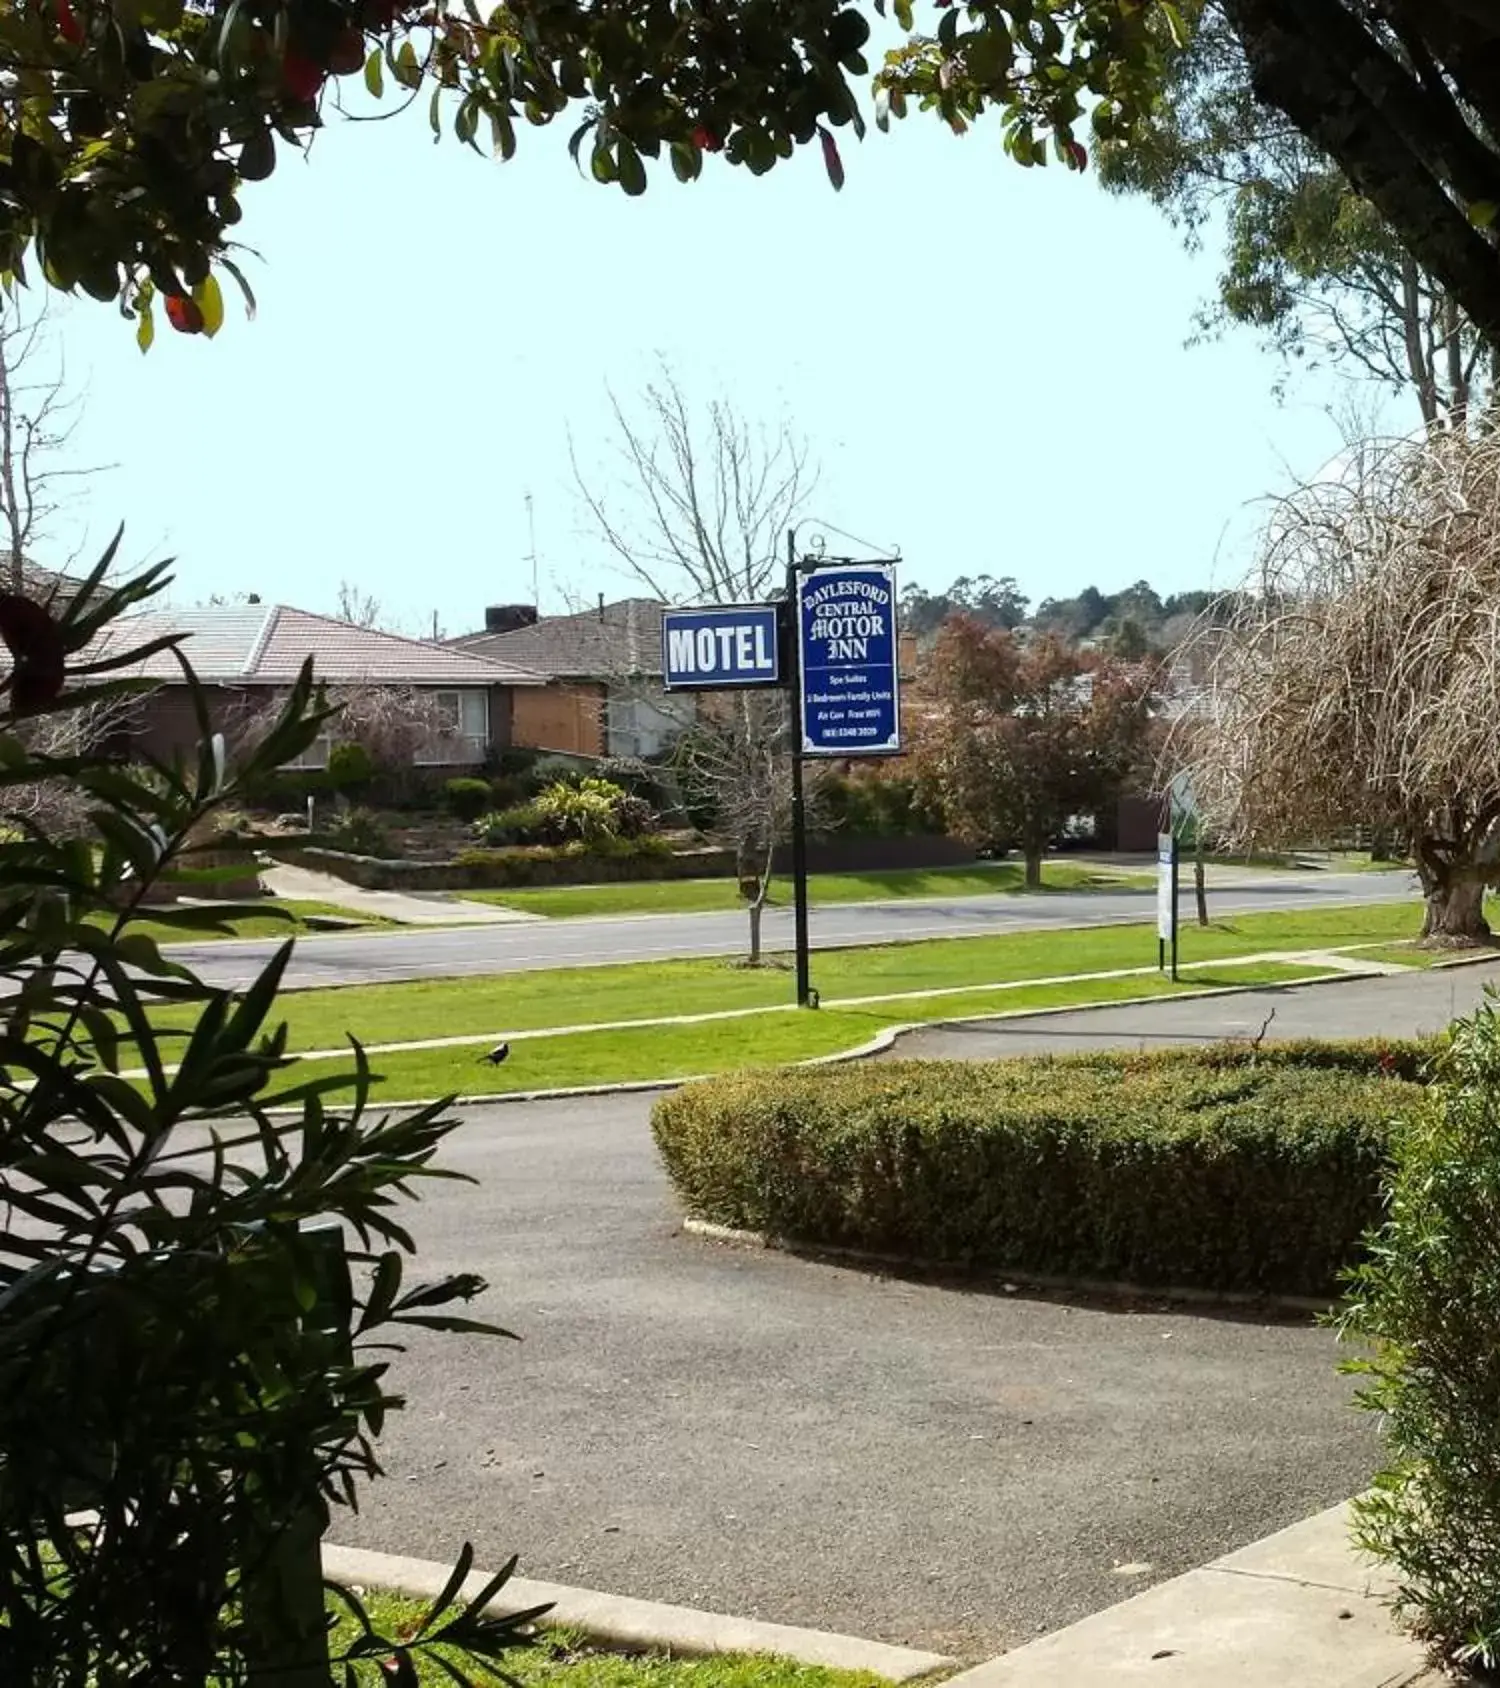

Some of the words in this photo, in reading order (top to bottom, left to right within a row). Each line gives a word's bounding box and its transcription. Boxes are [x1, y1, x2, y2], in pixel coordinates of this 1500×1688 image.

[804, 581, 889, 611] DAYLESFORD
[815, 600, 876, 617] CENTRAL
[809, 616, 885, 640] MOTOR
[668, 625, 773, 673] MOTEL
[827, 638, 868, 660] INN
[847, 691, 870, 703] Family
